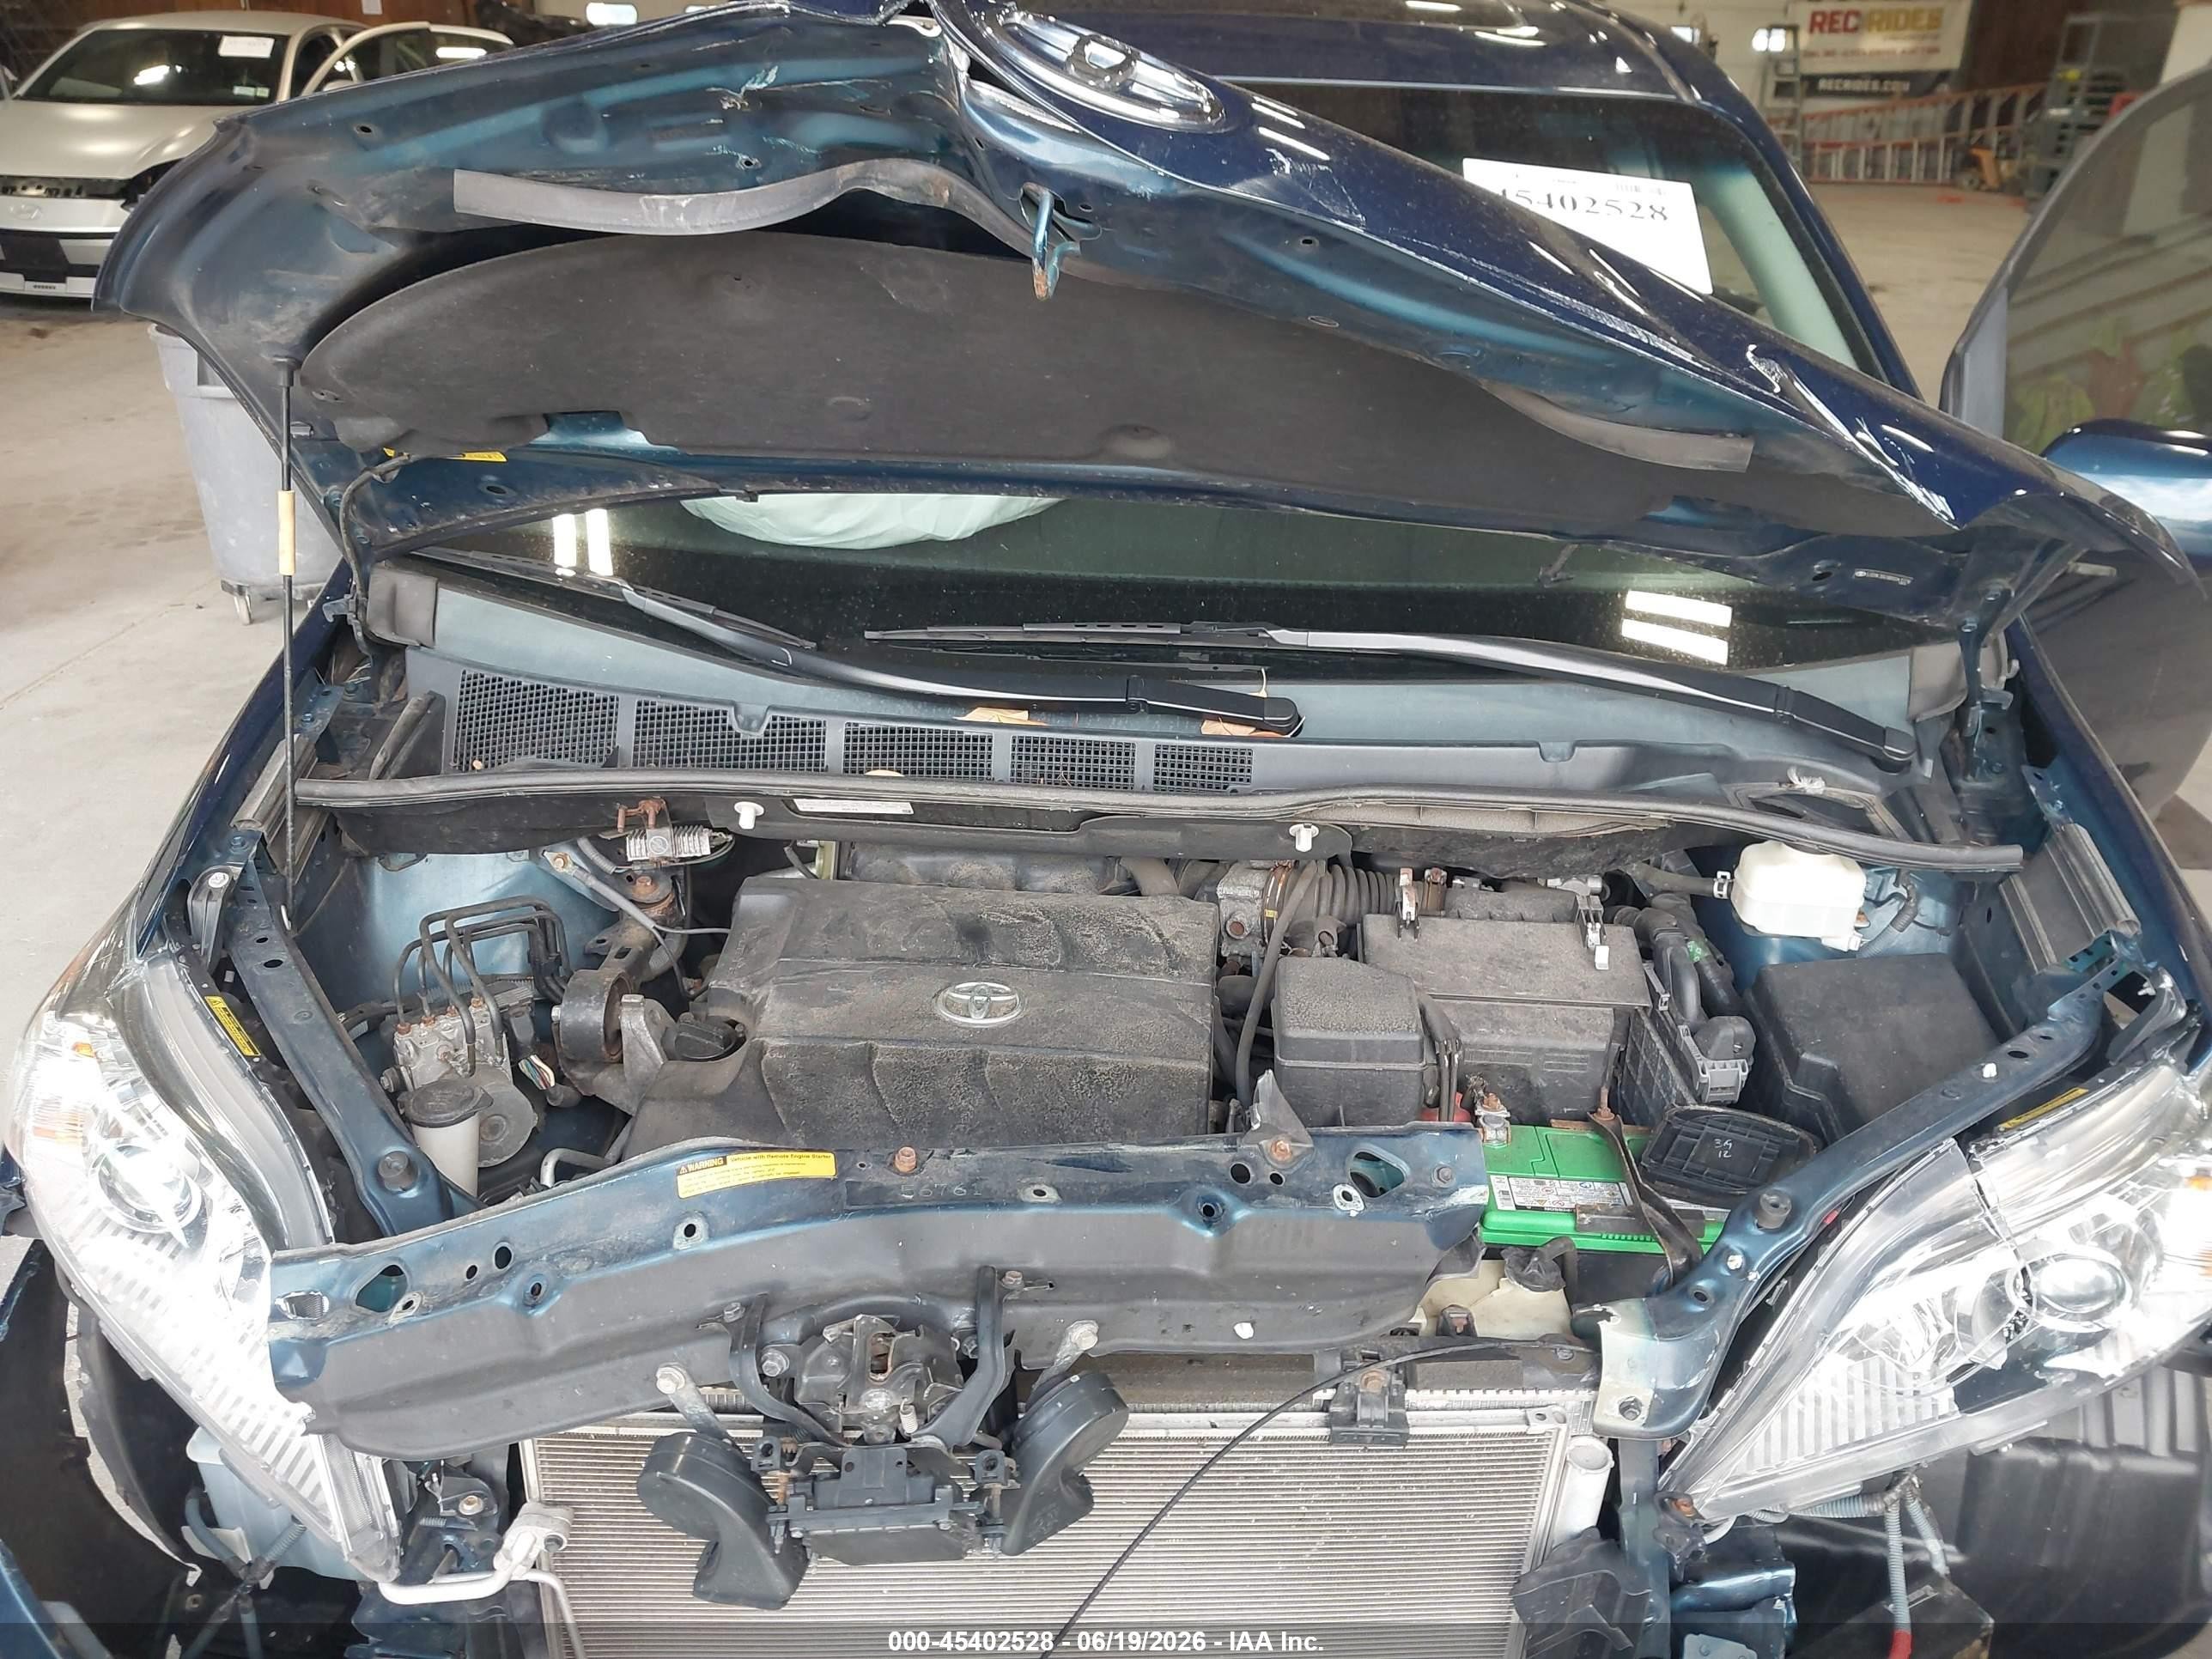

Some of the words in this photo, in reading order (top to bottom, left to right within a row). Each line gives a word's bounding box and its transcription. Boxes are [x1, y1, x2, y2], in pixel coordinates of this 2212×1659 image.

[1809, 9, 1862, 33] REC
[1868, 7, 1945, 32] RIDES
[687, 1157, 724, 1172] WARNING
